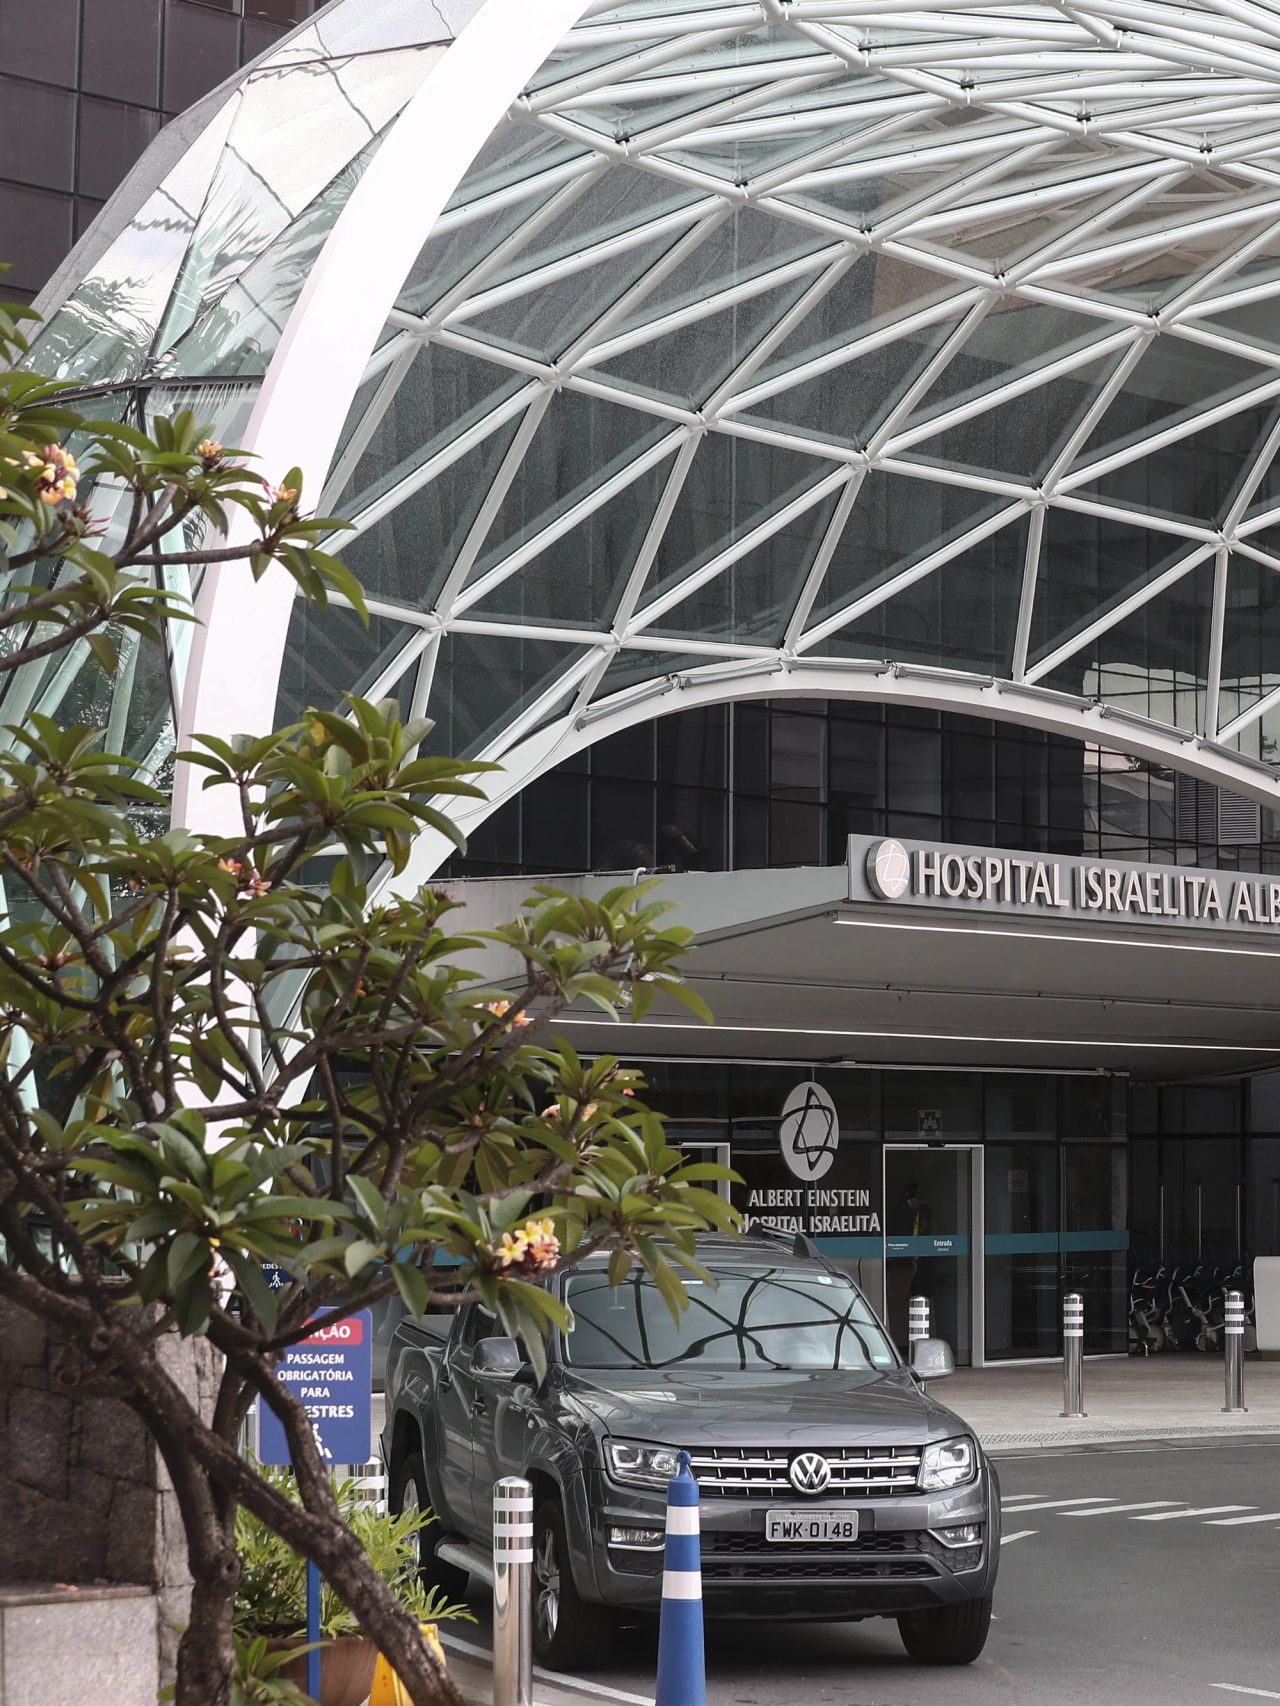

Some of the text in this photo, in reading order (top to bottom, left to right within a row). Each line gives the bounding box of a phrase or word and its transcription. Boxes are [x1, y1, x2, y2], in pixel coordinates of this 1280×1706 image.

[914, 850, 1069, 906] HOSPITAL
[1074, 865, 1222, 920] ISRAELITA
[748, 1189, 870, 1207] ALBERT EINSTEIN
[809, 1212, 881, 1233] ISRAELITA
[286, 1353, 345, 1364] PASSAGEM
[277, 1369, 354, 1381] OBRIGATÓRIA
[300, 1387, 330, 1398] PARA
[303, 1405, 354, 1418] ESTRES
